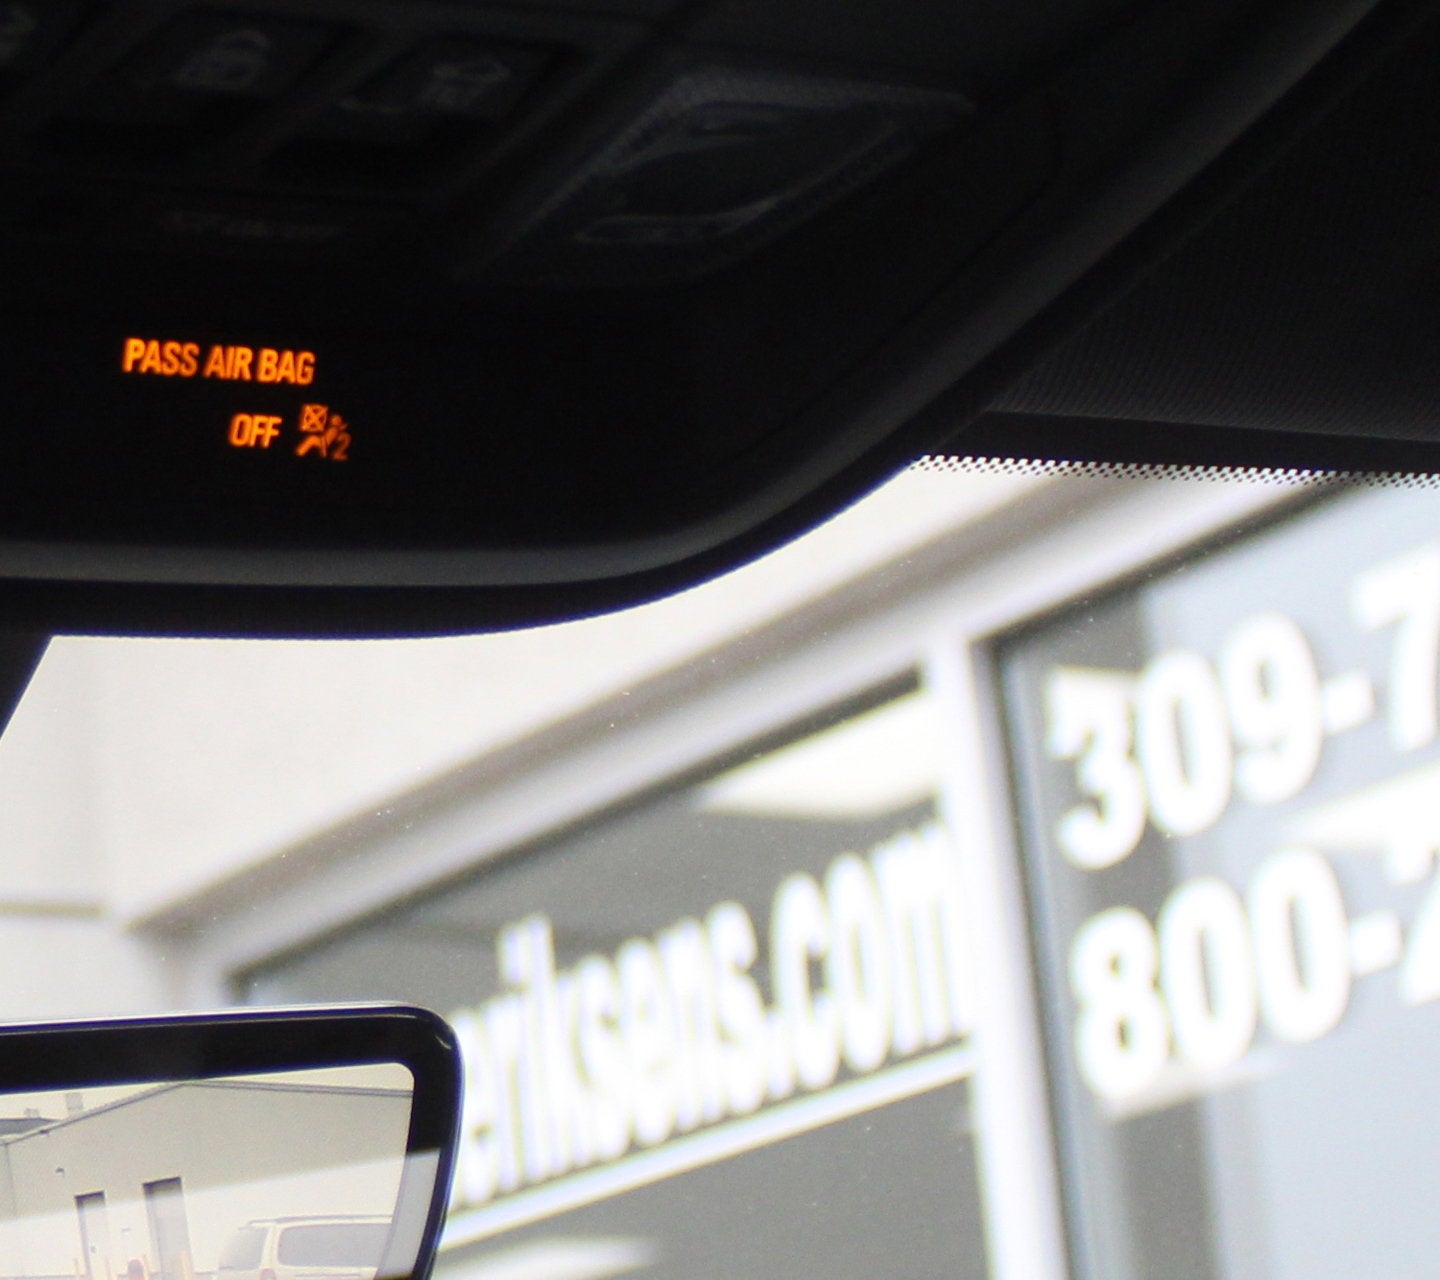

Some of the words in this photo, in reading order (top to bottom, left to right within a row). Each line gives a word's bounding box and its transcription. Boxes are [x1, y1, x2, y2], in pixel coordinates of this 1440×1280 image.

[123, 337, 200, 376] PASS
[203, 345, 252, 381] AIR
[256, 348, 315, 386] BAG
[228, 413, 283, 448] OFF
